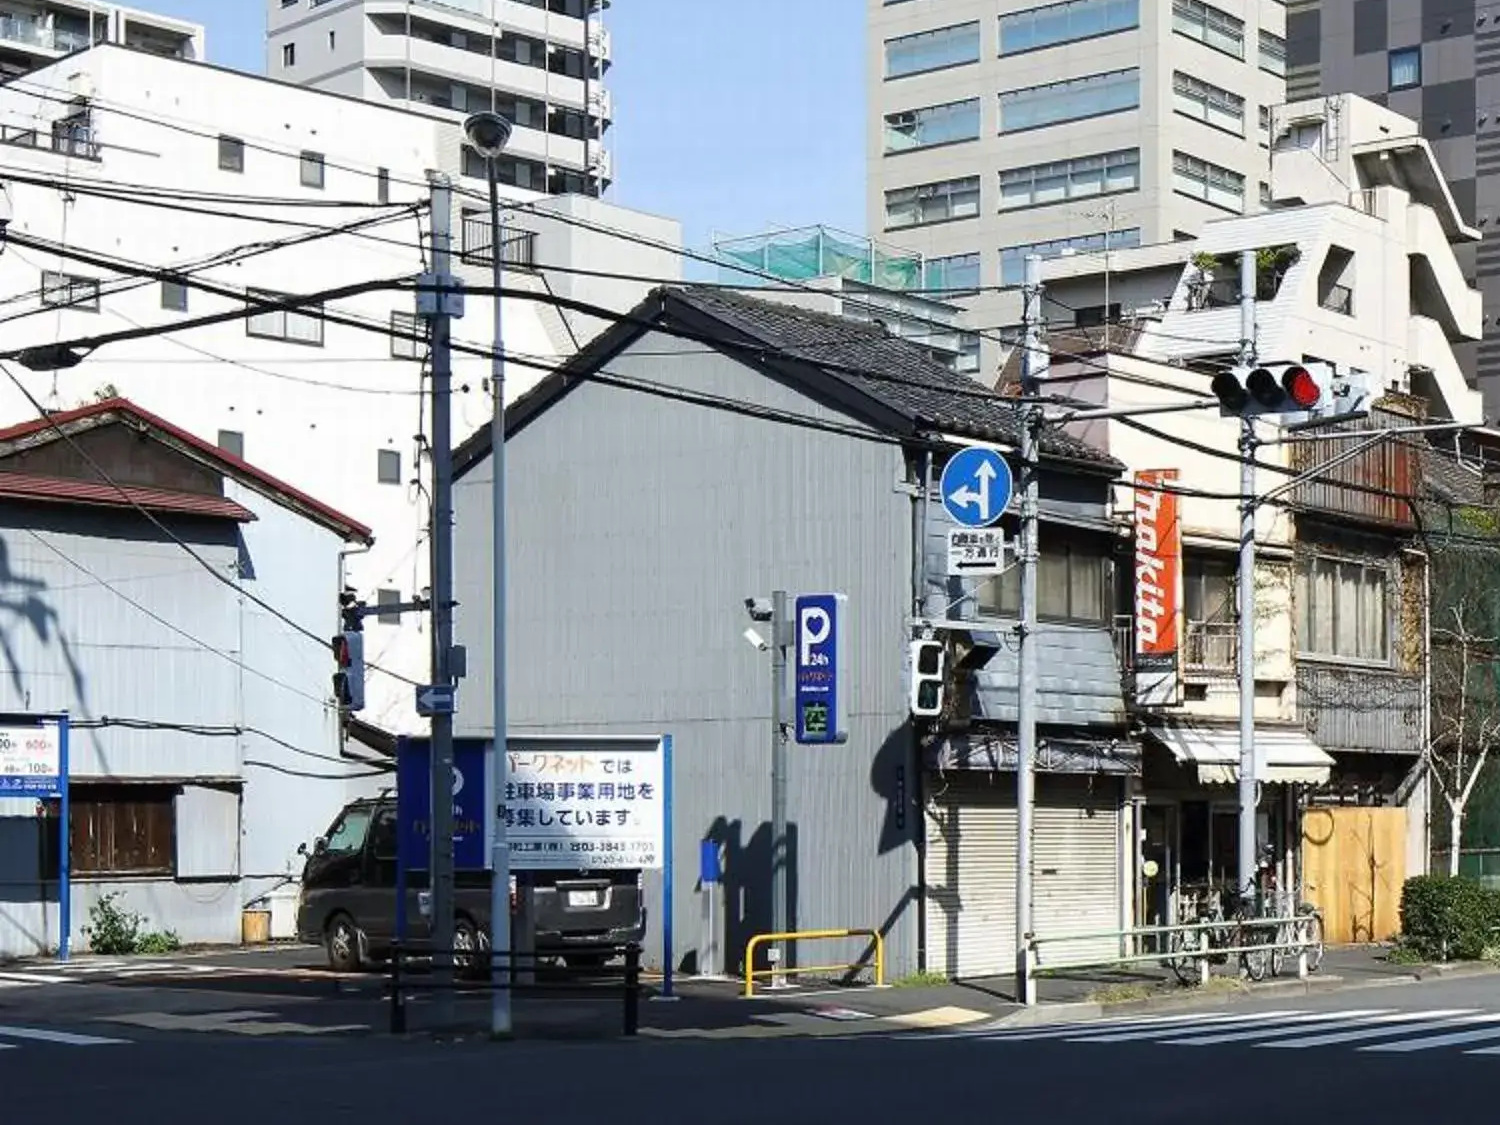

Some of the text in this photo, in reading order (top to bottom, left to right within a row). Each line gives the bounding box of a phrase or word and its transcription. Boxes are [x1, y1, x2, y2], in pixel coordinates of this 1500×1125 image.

[1135, 478, 1165, 653] makita
[801, 607, 831, 666] P
[600, 759, 633, 774] では
